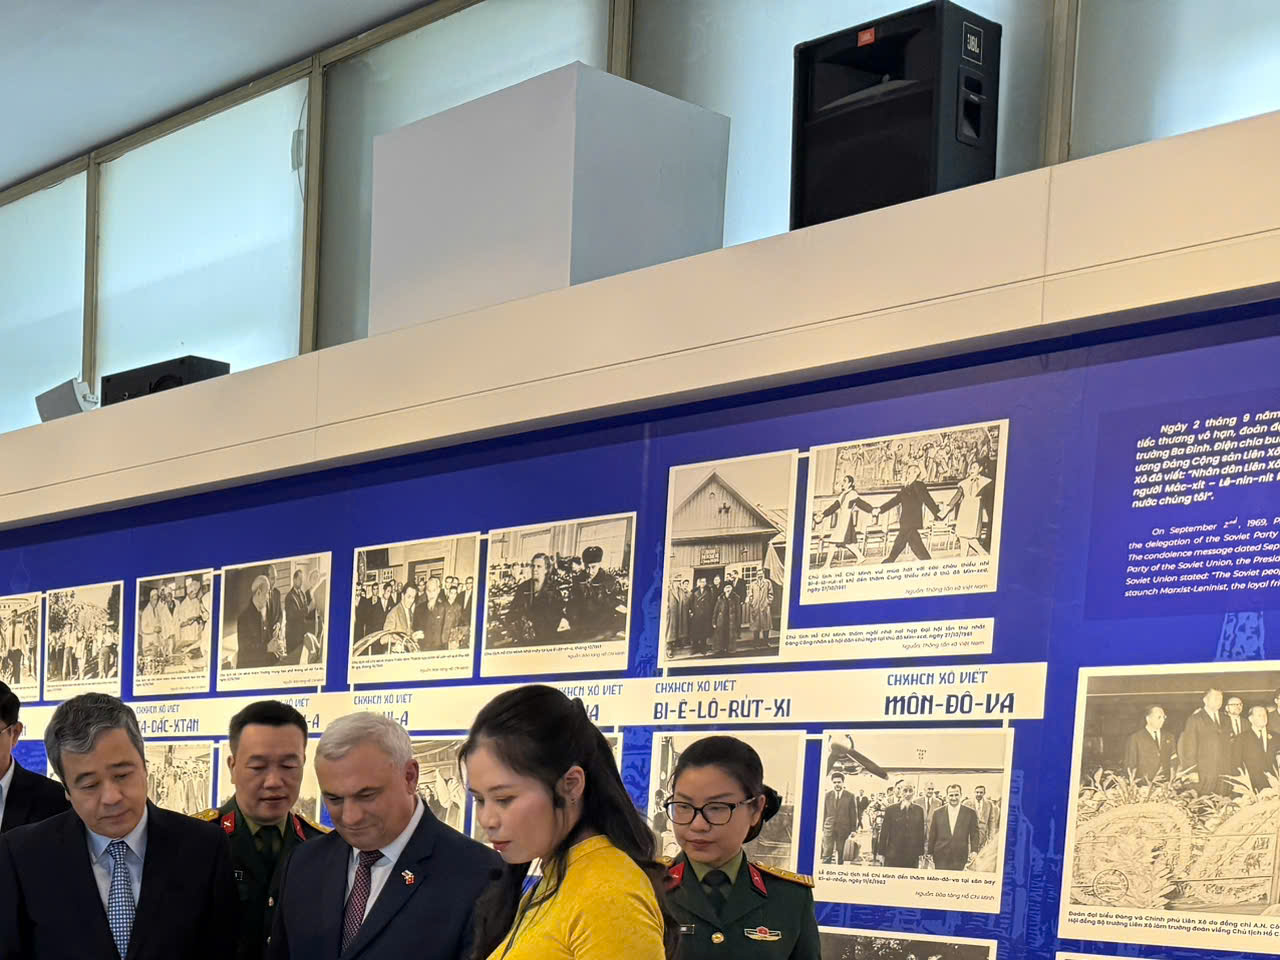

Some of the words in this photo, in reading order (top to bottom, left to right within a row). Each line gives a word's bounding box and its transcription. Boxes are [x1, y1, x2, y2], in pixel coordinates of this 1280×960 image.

[967, 33, 980, 54] JBL
[1160, 422, 1188, 434] Ngày
[1193, 420, 1200, 429] 2
[1205, 416, 1237, 427] tháng
[1243, 413, 1250, 422] 9
[1137, 436, 1156, 448] tiếc
[1158, 434, 1195, 445] thương
[1198, 430, 1210, 440] vô
[1213, 430, 1236, 439] hạn,
[1239, 424, 1268, 435] đoàn
[1136, 449, 1170, 460] trường
[1171, 447, 1185, 456] Ba
[1185, 443, 1212, 454] Đình.
[1214, 440, 1238, 451] Điện
[1239, 437, 1263, 447] chia
[1135, 463, 1161, 472] ương
[1162, 458, 1190, 469] Đảng
[1192, 455, 1220, 466] Cộng
[1221, 452, 1241, 462] sản
[1243, 449, 1265, 459] Liên
[1134, 474, 1147, 484] Xô
[1148, 472, 1163, 482] đã
[1221, 464, 1242, 474] dân
[1243, 462, 1266, 472] Liên
[1133, 484, 1163, 497] người
[1132, 497, 1157, 508] nước
[1159, 494, 1192, 506] chúng
[1152, 528, 1165, 536] On
[1169, 524, 1217, 534] September
[1247, 518, 1267, 527] 1969,
[1129, 542, 1143, 550] the
[1145, 538, 1191, 548] delegation
[1193, 535, 1204, 544] of
[1206, 535, 1221, 543] the
[1223, 532, 1251, 541] Soviet
[1253, 531, 1279, 539] Party
[1128, 553, 1143, 561] The
[1144, 551, 1193, 560] condolence
[1193, 547, 1233, 557] message
[1234, 543, 1262, 553] dated
[1127, 565, 1149, 573] Party
[1151, 563, 1161, 571] of
[1161, 563, 1176, 571] the
[1177, 560, 1204, 569] Soviet
[1206, 559, 1233, 567] Union,
[1125, 577, 1151, 585] Soviet
[1152, 575, 1178, 583] Union
[1180, 572, 1209, 581] stated:
[1233, 569, 1260, 578] Soviet
[1124, 588, 1158, 597] staunch
[1231, 582, 1246, 590] the
[1247, 580, 1269, 589] loyal
[887, 673, 934, 686] CHXHCN
[939, 670, 955, 685] XÔ
[655, 681, 694, 694] CHXHCN
[653, 694, 792, 720] BI-Ê-LÔ-RÚT-XI
[884, 690, 1015, 716] MÔN-ĐÔ-VA
[138, 715, 199, 733] A-DẮC-XTAN
[1220, 919, 1238, 928] đồng
